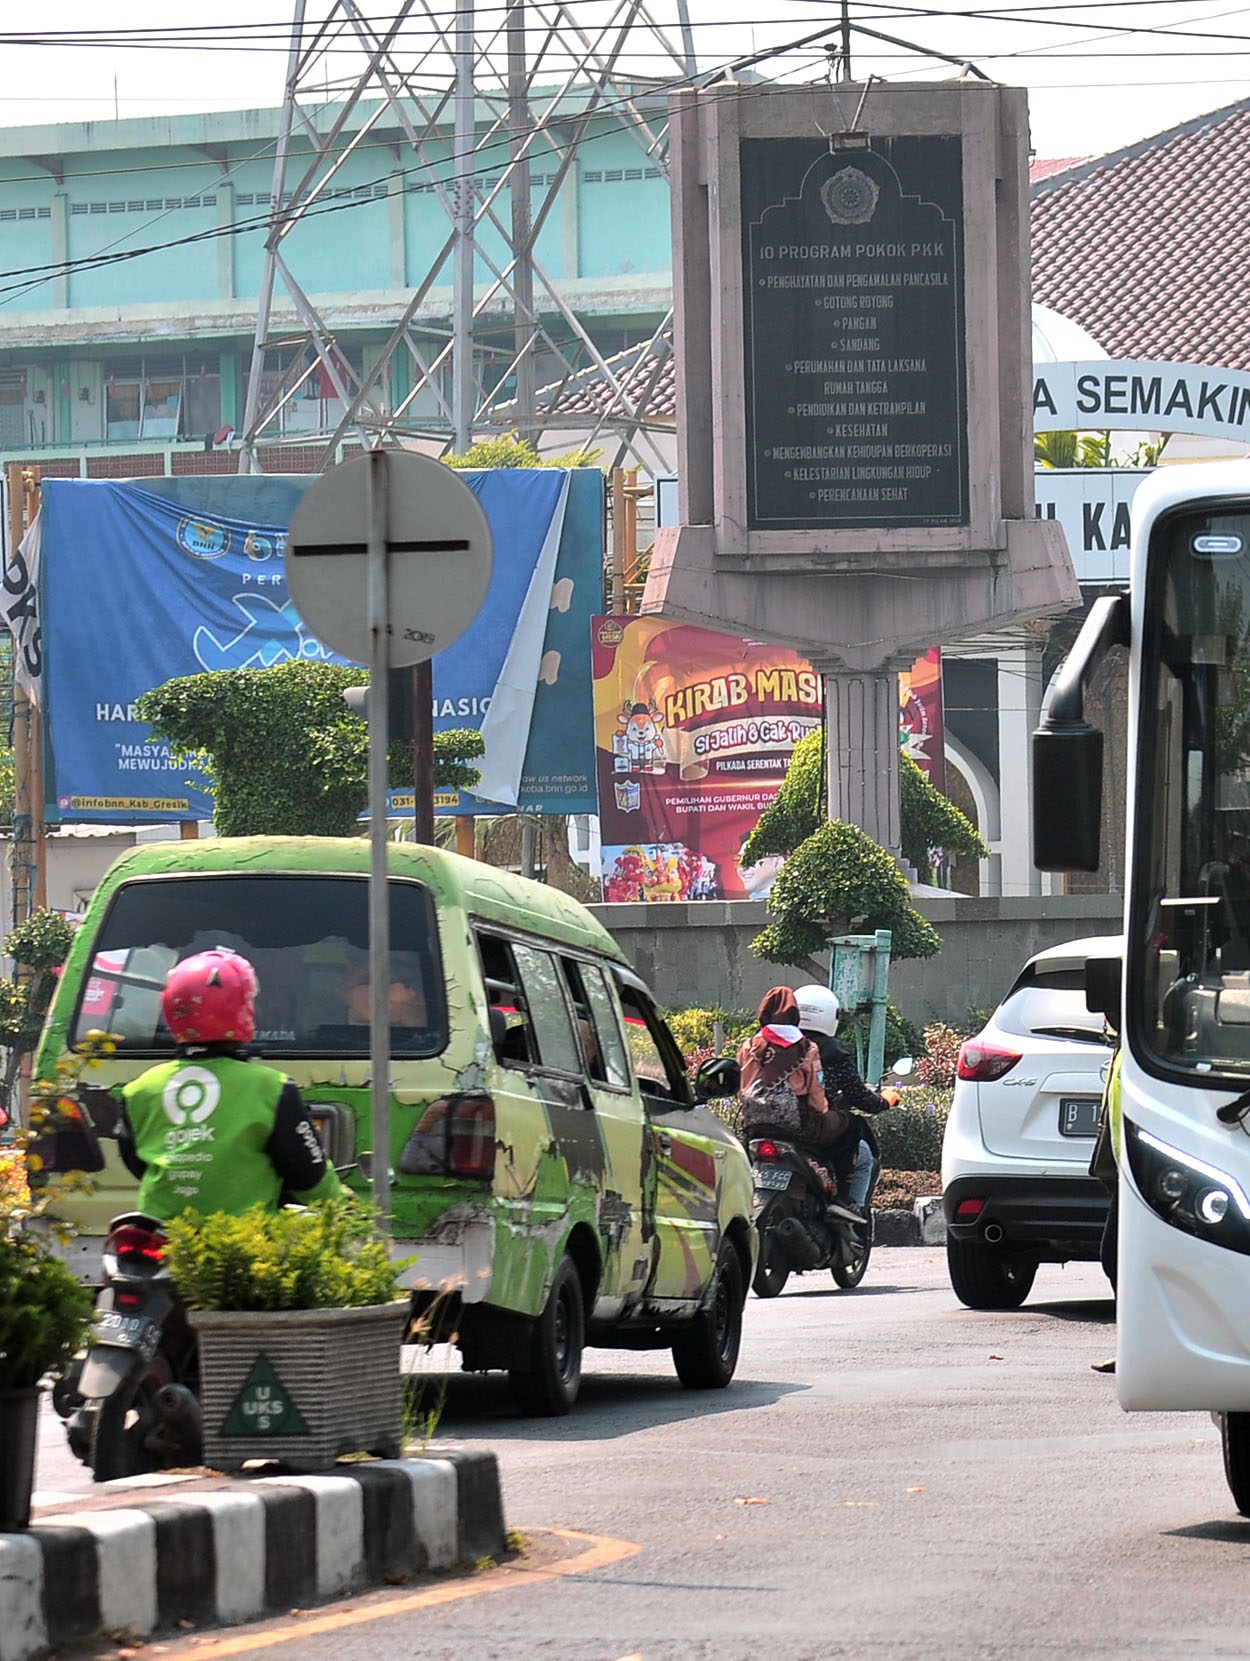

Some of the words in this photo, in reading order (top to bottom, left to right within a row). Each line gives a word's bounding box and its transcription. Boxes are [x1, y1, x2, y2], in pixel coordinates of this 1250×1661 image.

[779, 244, 851, 260] PROGRAM
[856, 243, 906, 258] POKOK
[911, 242, 945, 257] PKK
[903, 272, 949, 286] PANCASILA
[823, 296, 858, 309] GOTONG
[859, 295, 894, 308] ROYONG
[842, 317, 877, 330] PANGAN
[839, 338, 881, 352] SANDANG
[794, 360, 846, 374] PERUMAHAN
[847, 360, 865, 373] DAN
[866, 359, 887, 372] TATA
[888, 358, 927, 372] LAKSANA
[824, 381, 853, 395] RUMAH
[855, 381, 888, 394] TANGGA
[796, 403, 847, 417] PENDIDIKAN
[848, 403, 866, 416] DAN
[867, 402, 926, 416] KETRAMPILAN
[835, 423, 888, 437] KESEHATAN
[773, 445, 845, 460] MENGEMBANGKAN
[847, 444, 893, 459] KEHIDUPAN
[895, 443, 952, 458] BERKOPERASI
[793, 466, 851, 481] KELESTARIAN
[852, 466, 905, 480] LINGKUNGAN
[906, 465, 932, 479] HIDUP
[881, 487, 909, 501] SEHAT
[666, 674, 749, 729] KIRAB
[716, 760, 746, 771] PILKADA
[747, 758, 782, 770] SERENTAK
[666, 795, 712, 806] PEMILIHAN
[714, 794, 761, 804] GUBERNUR
[676, 804, 706, 814] BUPATI
[708, 804, 727, 813] DAN
[728, 803, 756, 812] WAKIL
[1068, 1103, 1078, 1122] B
[165, 1124, 216, 1150] gojek
[243, 1400, 284, 1416] UKS
